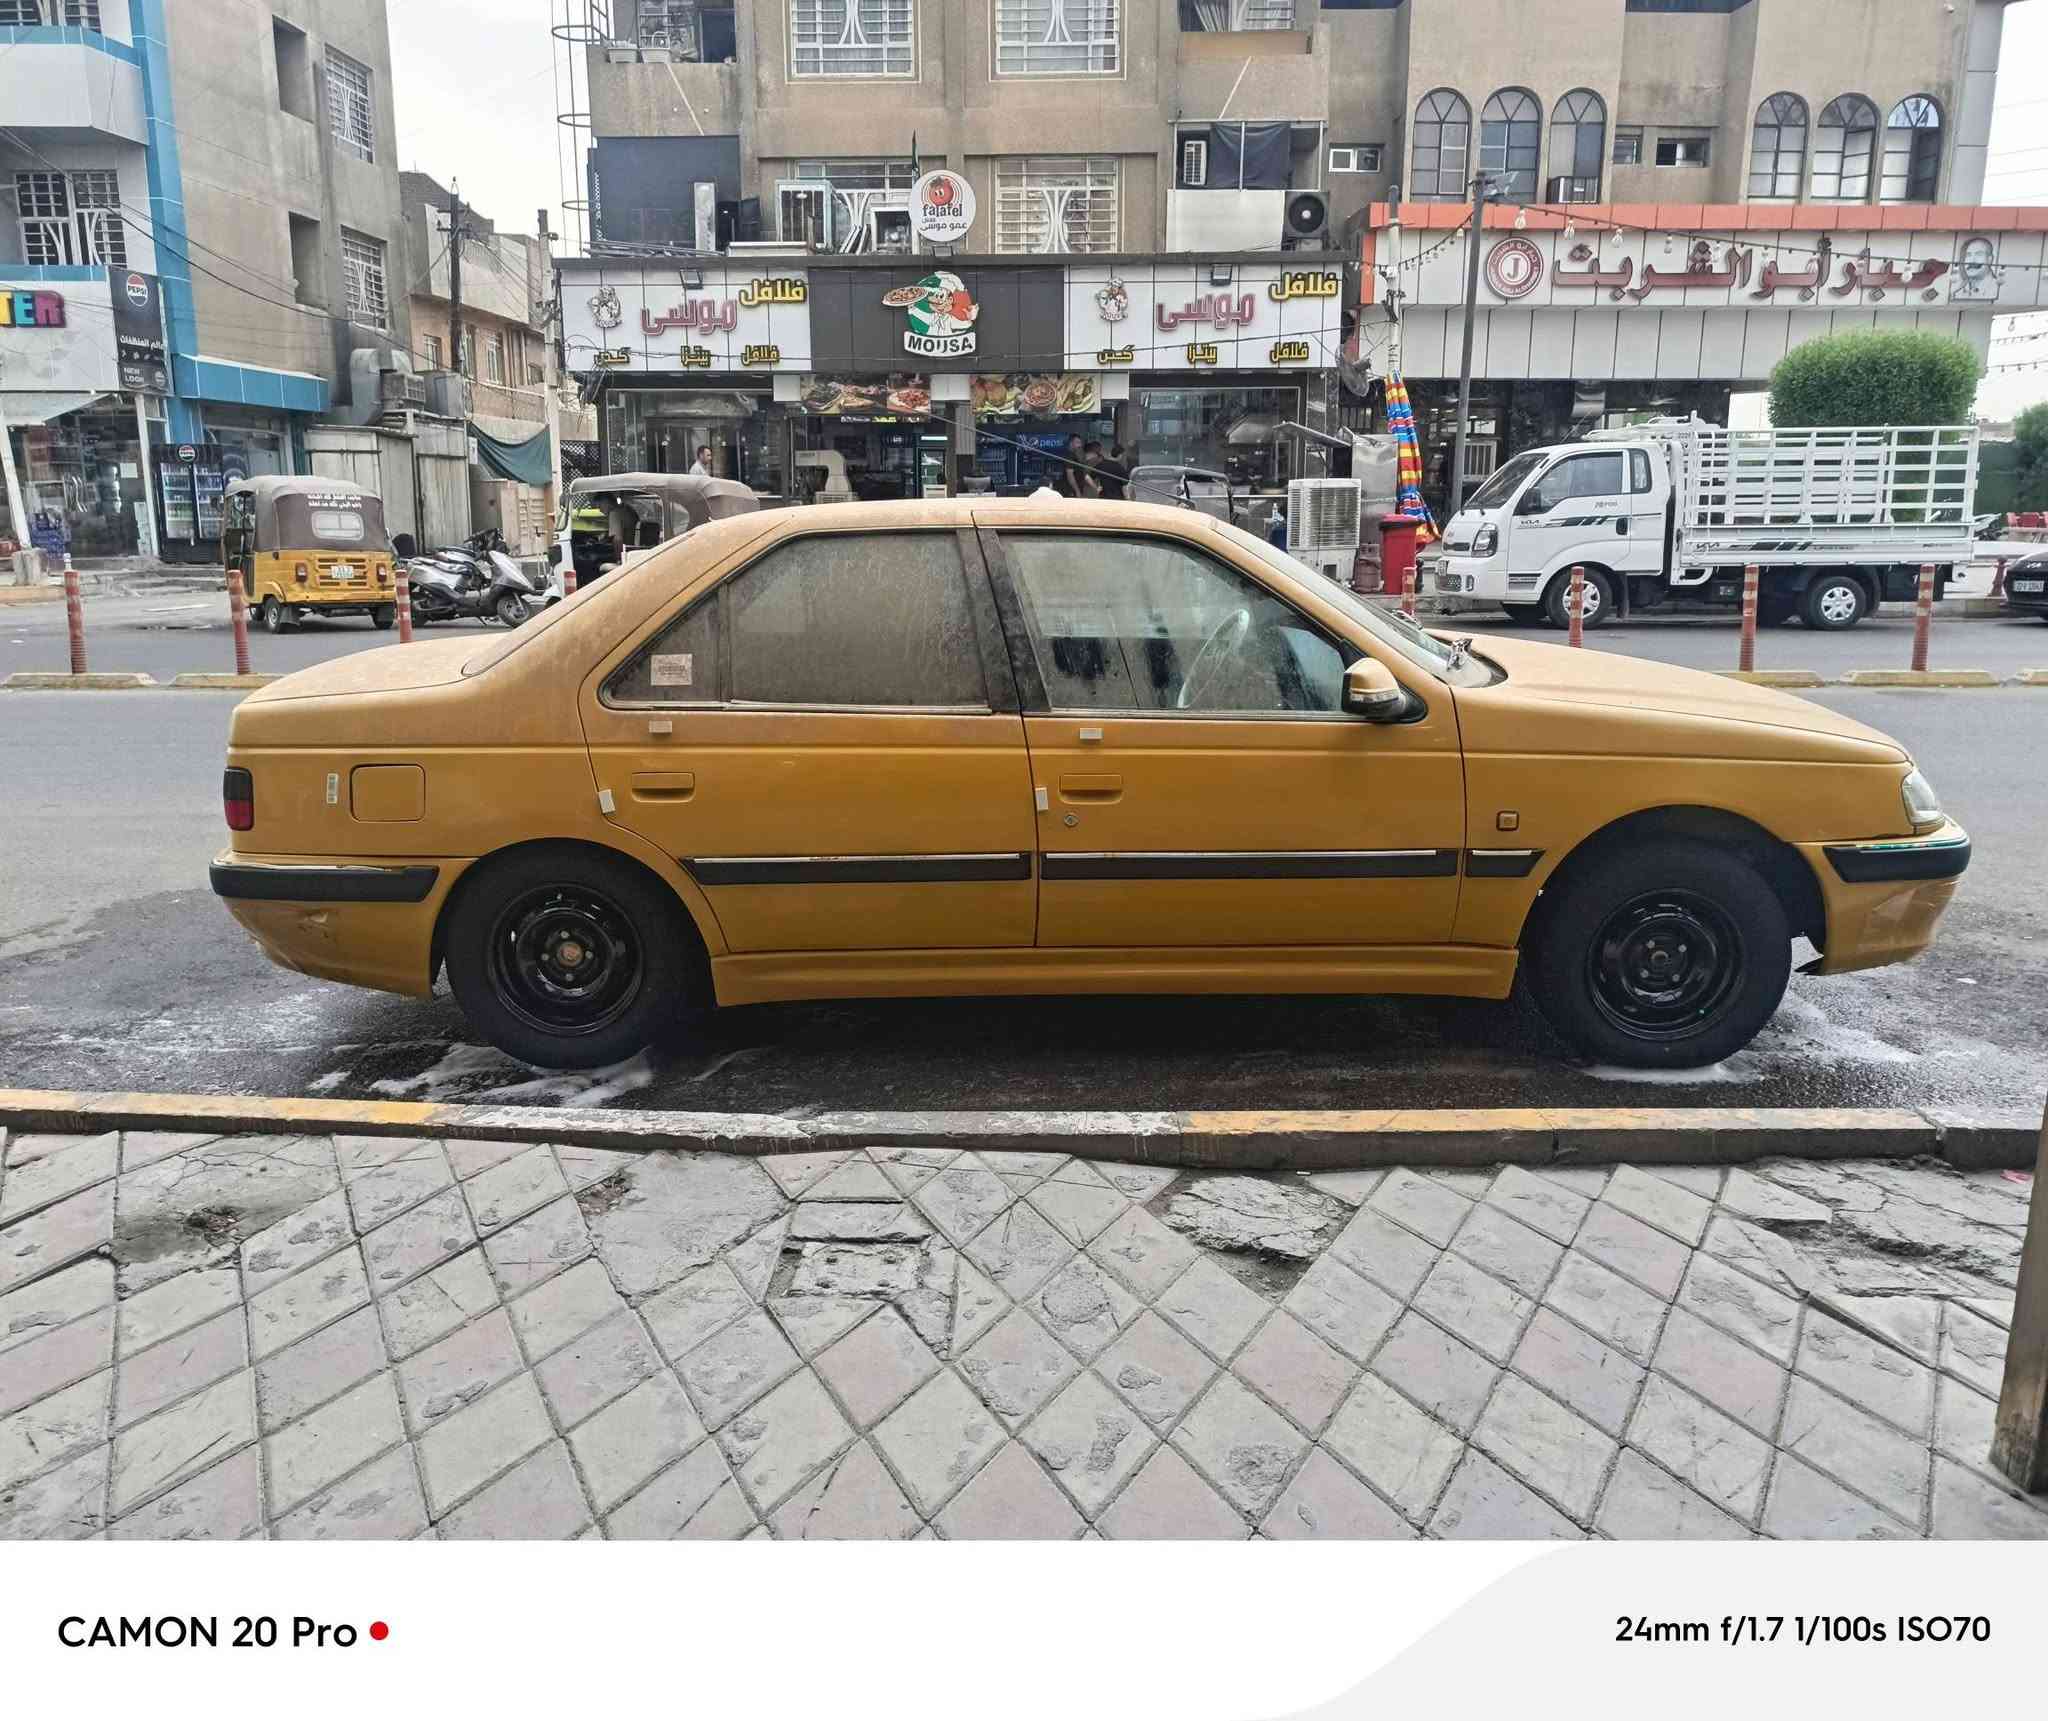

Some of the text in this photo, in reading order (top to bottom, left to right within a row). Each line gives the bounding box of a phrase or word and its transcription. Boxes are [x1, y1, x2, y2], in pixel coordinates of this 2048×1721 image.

[922, 203, 963, 217] falafel
[949, 222, 967, 231] عمو
[1507, 257, 1521, 280] J
[1551, 239, 1754, 301] الشربت
[1830, 247, 1950, 301] جبار
[739, 278, 807, 308] فلافل
[1269, 271, 1339, 302] فلافل
[640, 299, 738, 336] موسى
[1156, 294, 1256, 331] موسى
[741, 345, 780, 366] فلافل
[907, 334, 973, 353] MOUSA
[1270, 341, 1310, 363] فلافل
